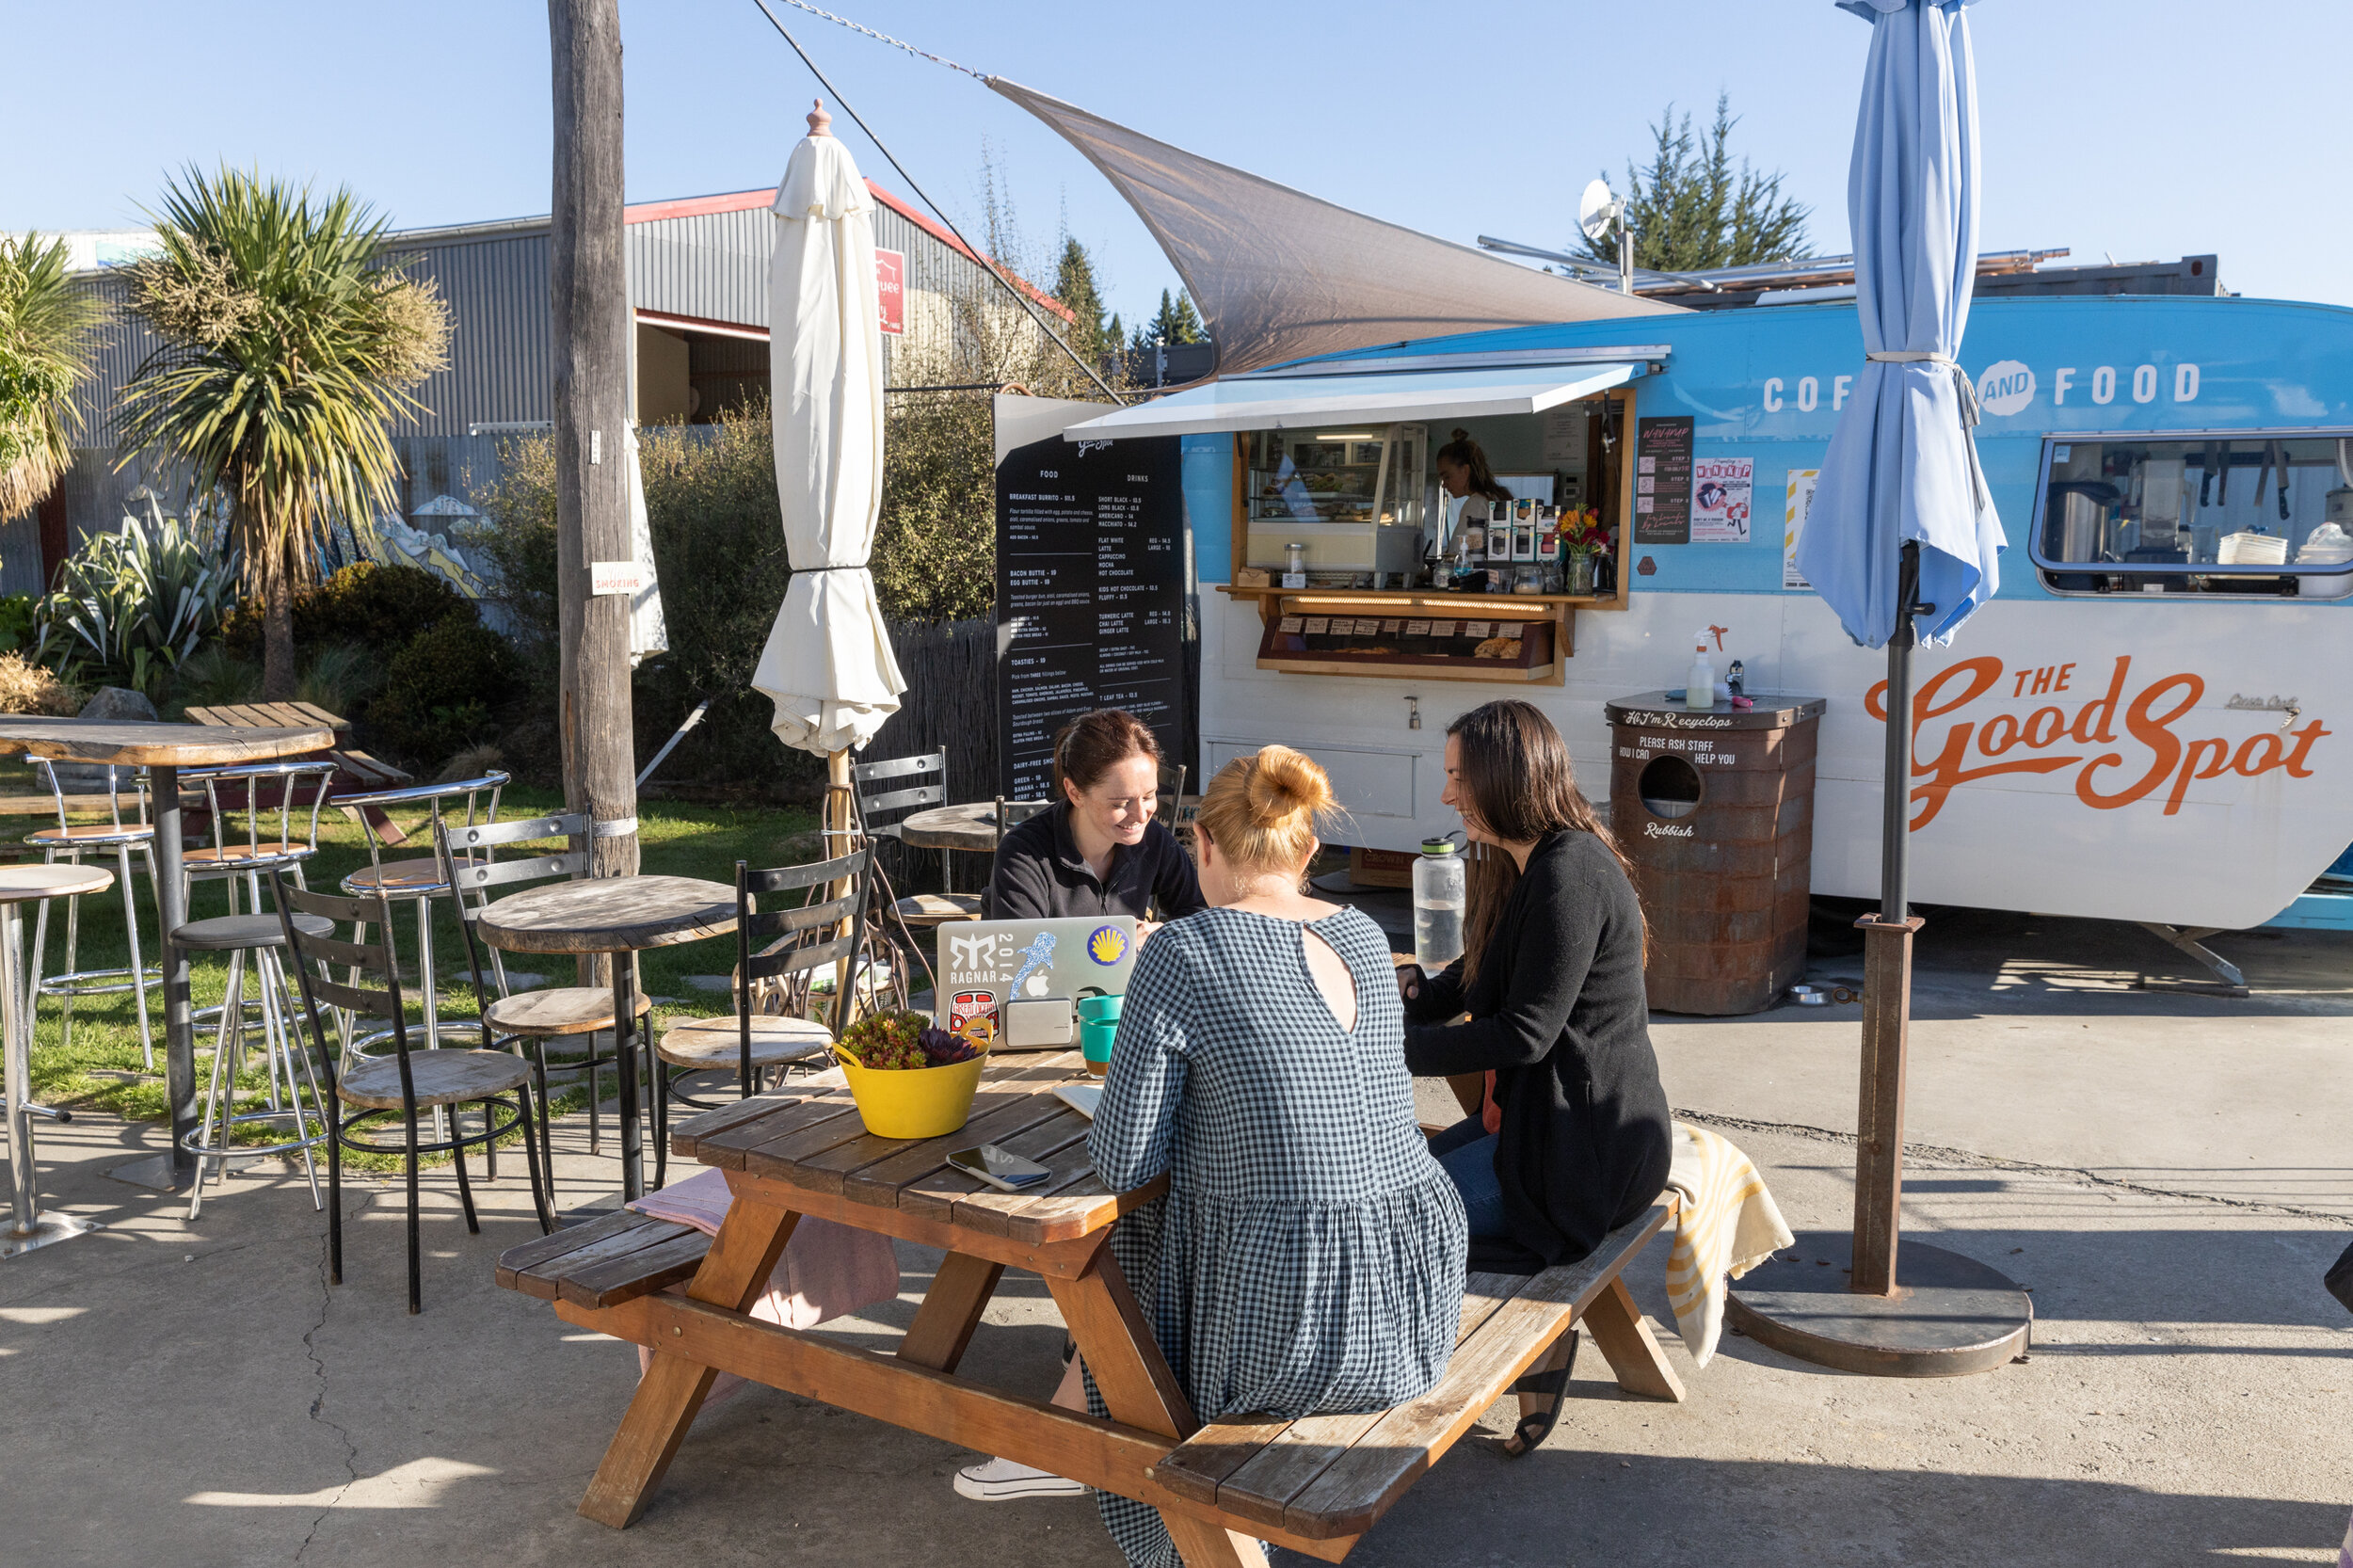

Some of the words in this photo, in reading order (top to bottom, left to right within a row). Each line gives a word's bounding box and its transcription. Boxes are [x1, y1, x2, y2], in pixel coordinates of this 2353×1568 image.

[1764, 376, 1852, 412] COF
[1983, 372, 2029, 402] AND
[2055, 363, 2200, 405] FOOD
[1040, 470, 1058, 478] FOOD
[1697, 465, 1751, 477] WANAKUP
[595, 579, 639, 588] SMOKING
[1011, 658, 1034, 666] TOASTIES
[2013, 663, 2076, 697] THE
[1665, 712, 1733, 728] Recyclops
[1640, 736, 1666, 749] PLEASE
[1669, 739, 1686, 750] ASK
[1688, 740, 1714, 752] STAFF
[1864, 655, 2131, 832] Good
[2075, 673, 2332, 816] Spot
[1620, 746, 1631, 758] HOW
[1636, 747, 1650, 760] CAN
[1694, 753, 1716, 764] HELP
[1719, 754, 1736, 765] YOU
[1014, 760, 1041, 770] DAIRY-FREE
[1015, 784, 1034, 792] BANANA
[1644, 822, 1694, 839] Rubbish
[999, 933, 1014, 983] 2014
[951, 970, 997, 984] RAGNAR
[953, 1003, 974, 1015] GREAT
[975, 1002, 995, 1015] OCEAN
